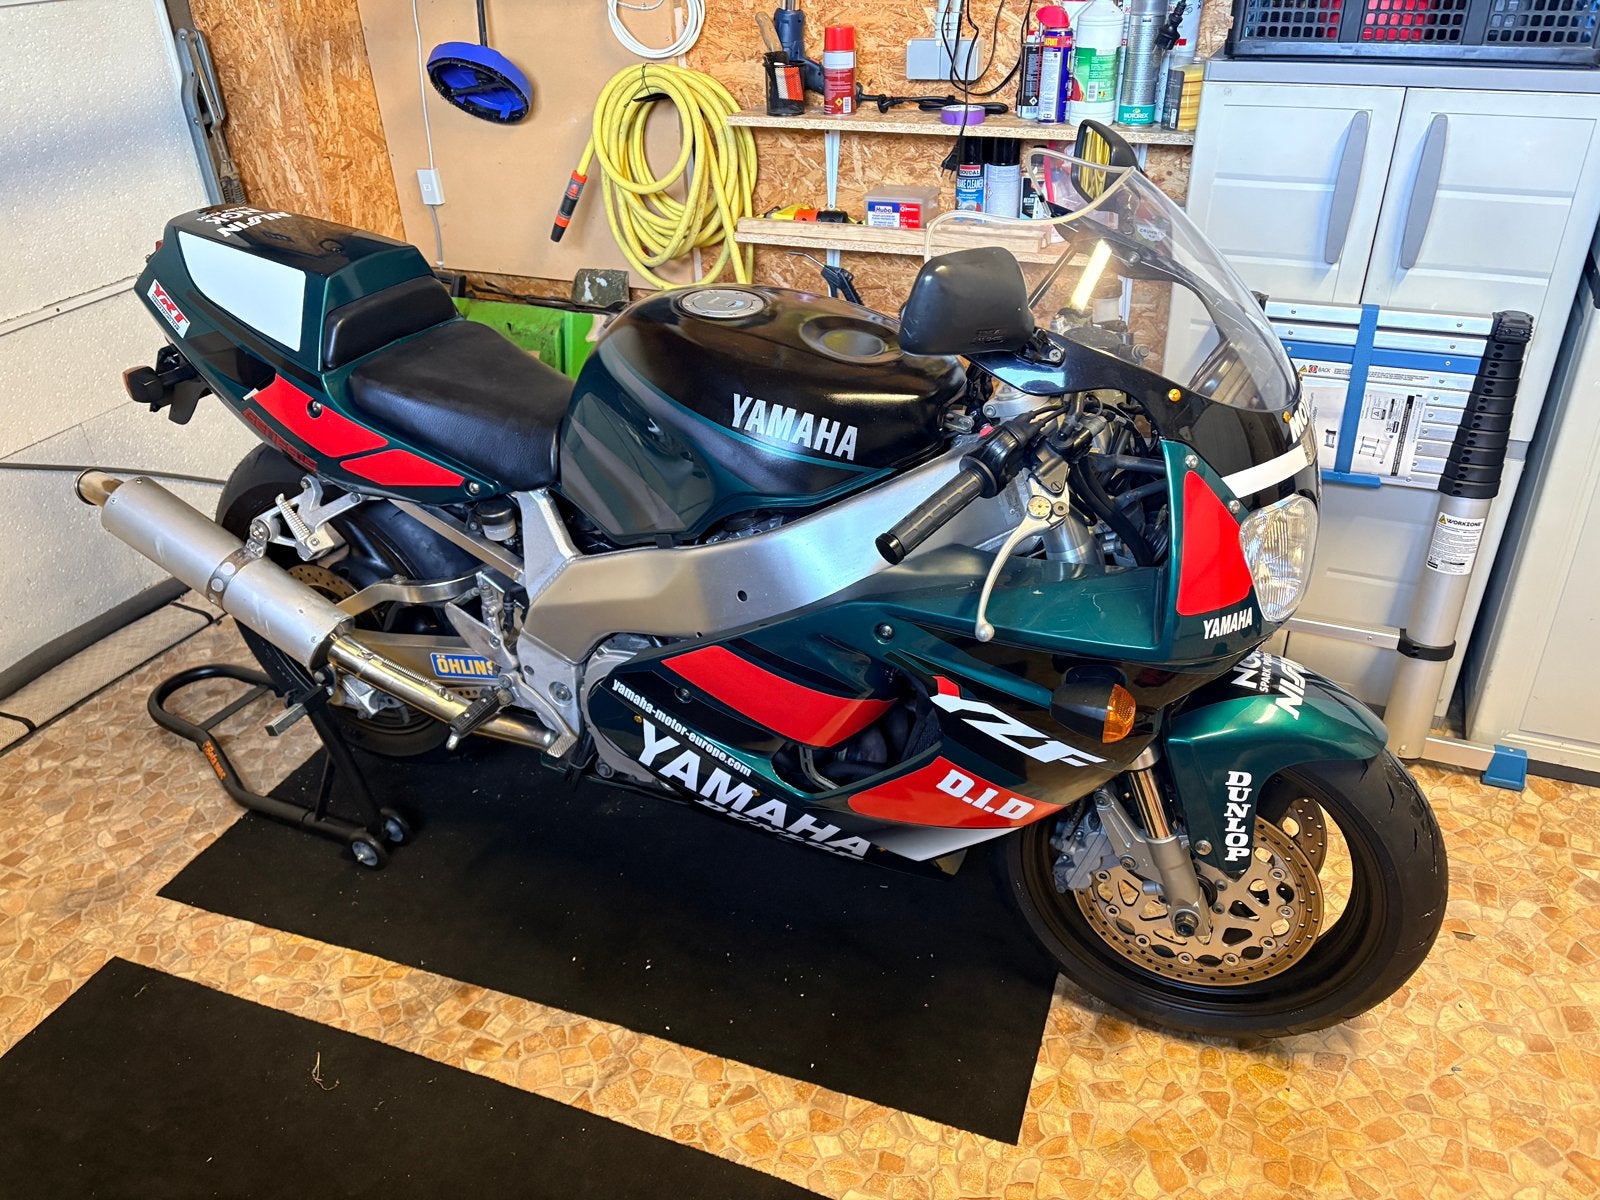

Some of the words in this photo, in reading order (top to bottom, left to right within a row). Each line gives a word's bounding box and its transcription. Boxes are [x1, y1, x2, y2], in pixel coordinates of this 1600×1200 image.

[205, 207, 264, 224] NGK
[153, 282, 189, 323] YRT
[731, 393, 859, 461] YAMAHA
[1446, 518, 1482, 527] WORKZONE
[1203, 606, 1253, 640] YAMAHA
[1260, 666, 1272, 693] SPARK
[611, 678, 752, 778] yamaha-motor-europe.com
[929, 675, 1107, 767] YZF
[638, 717, 871, 857] YAMAHA
[936, 769, 1035, 820] D.I.D
[1223, 770, 1253, 862] DUNLOP
